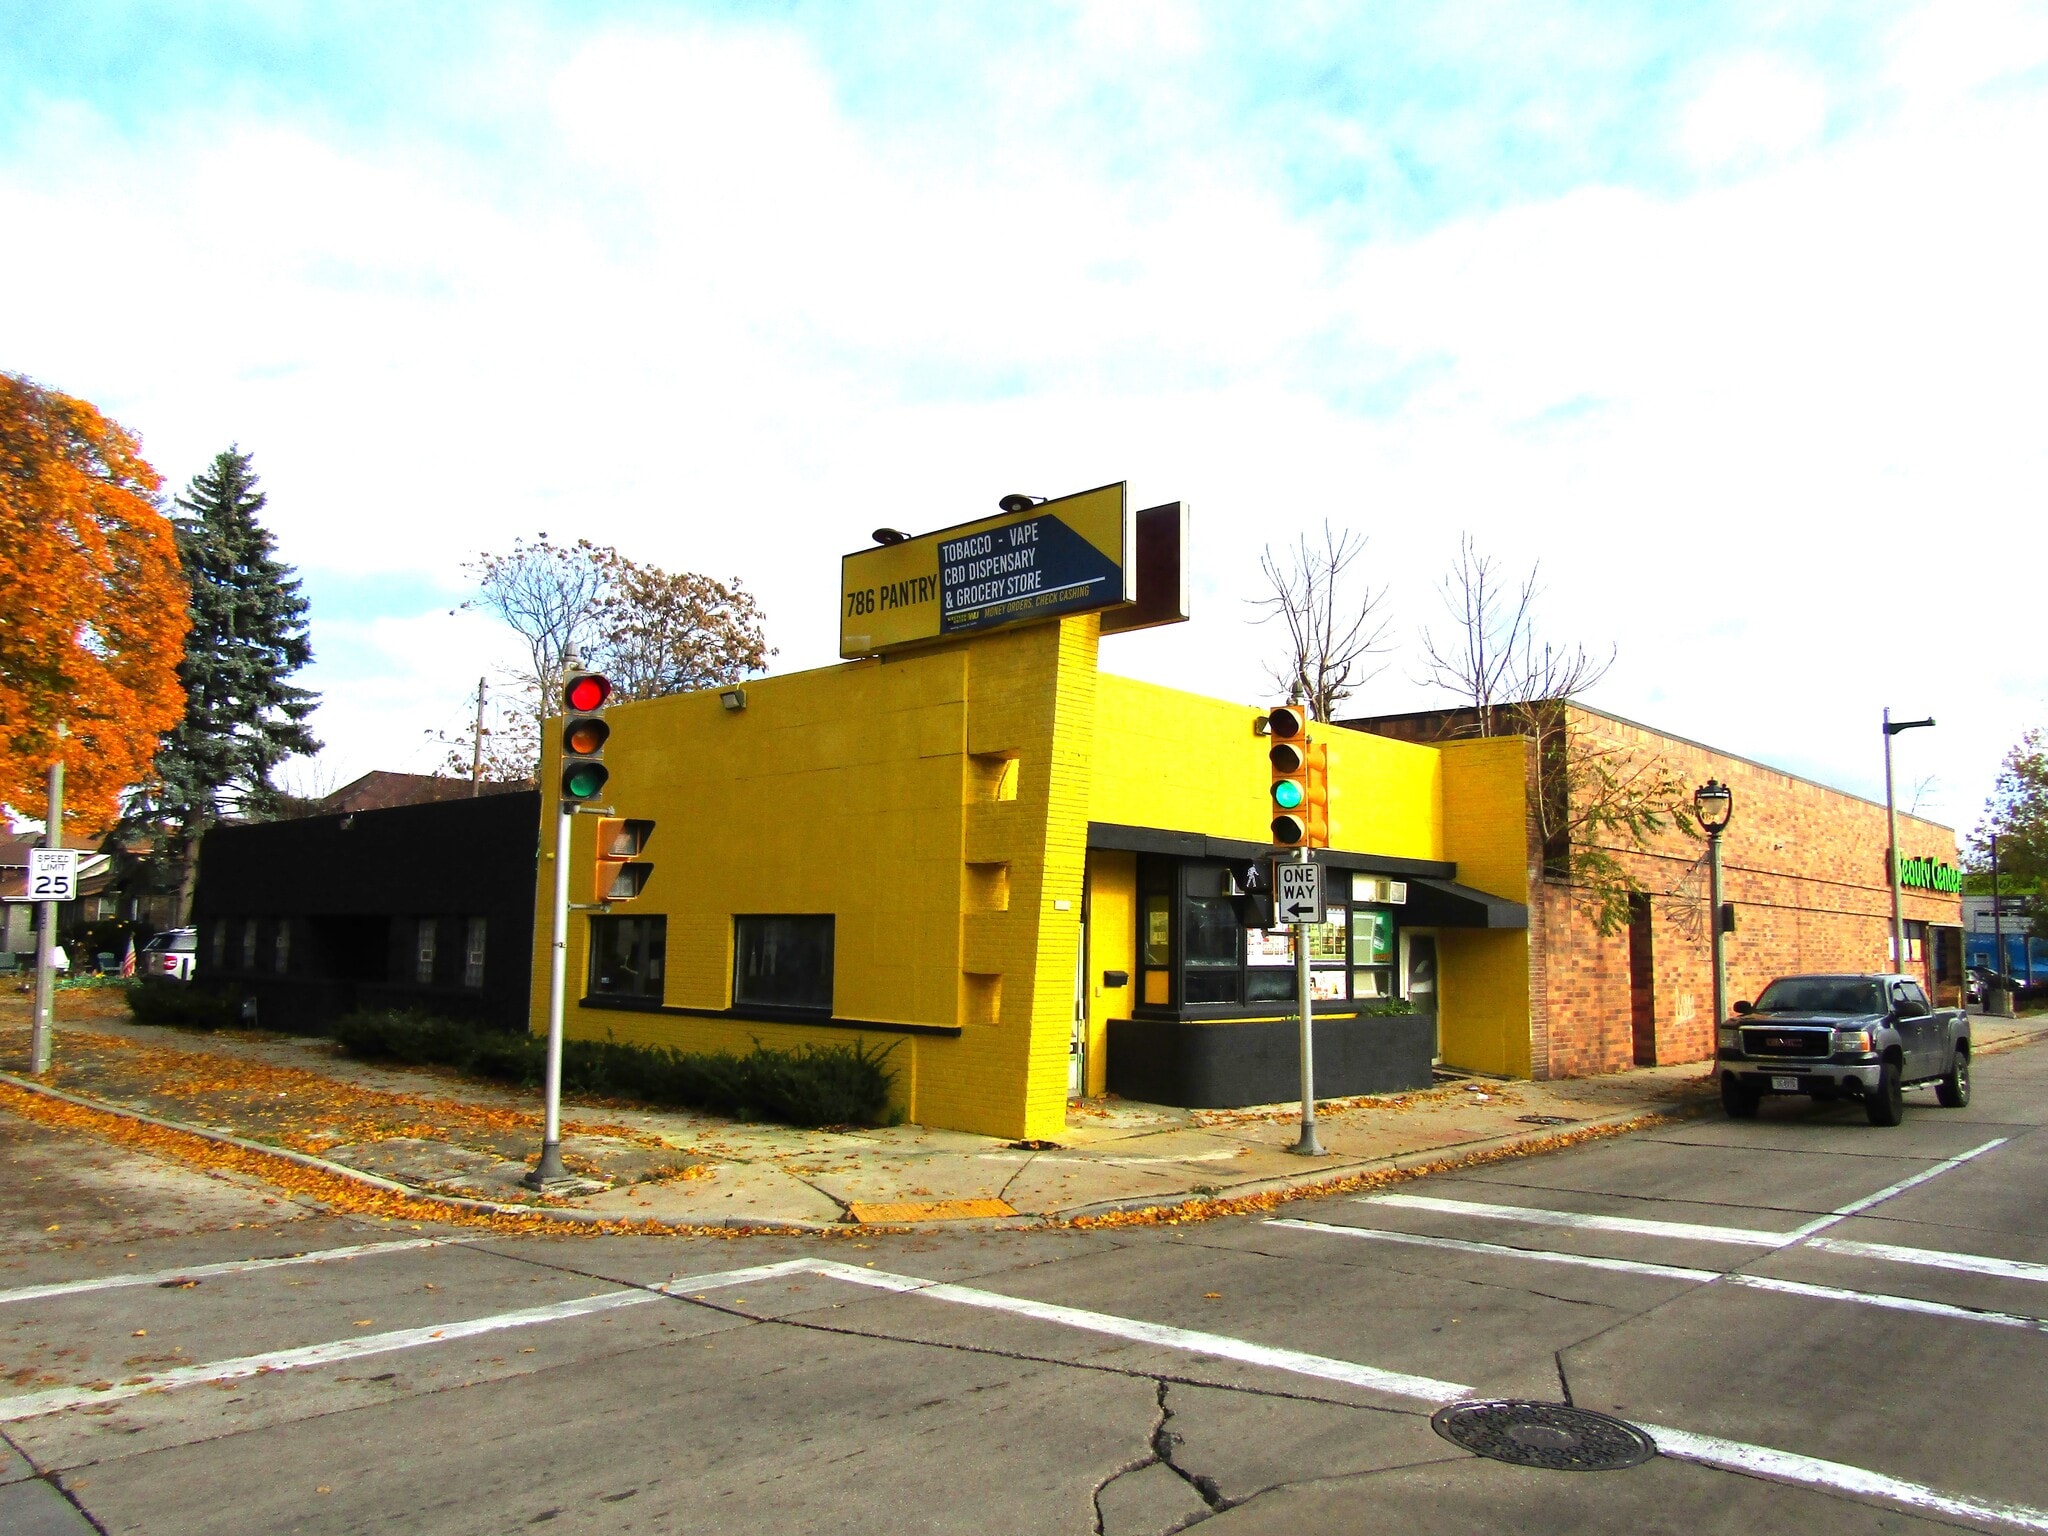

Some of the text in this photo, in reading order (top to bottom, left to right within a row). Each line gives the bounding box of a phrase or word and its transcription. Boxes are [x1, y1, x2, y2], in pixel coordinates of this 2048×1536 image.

[943, 535, 992, 563] TOBACCO
[1009, 523, 1039, 547] VAPE
[944, 548, 1036, 587] CBD DISPENSARY
[847, 574, 938, 618] 786 PANTRY
[945, 570, 1042, 610] & GROCERY STORE
[984, 604, 1006, 619] MONEY
[1035, 592, 1058, 607] CHECK
[1058, 585, 1090, 603] CASHING
[37, 854, 69, 863] SPEED
[41, 863, 66, 871] LIMIT
[35, 875, 69, 894] 25
[1283, 868, 1314, 882] ONE
[1283, 885, 1316, 899] WAY
